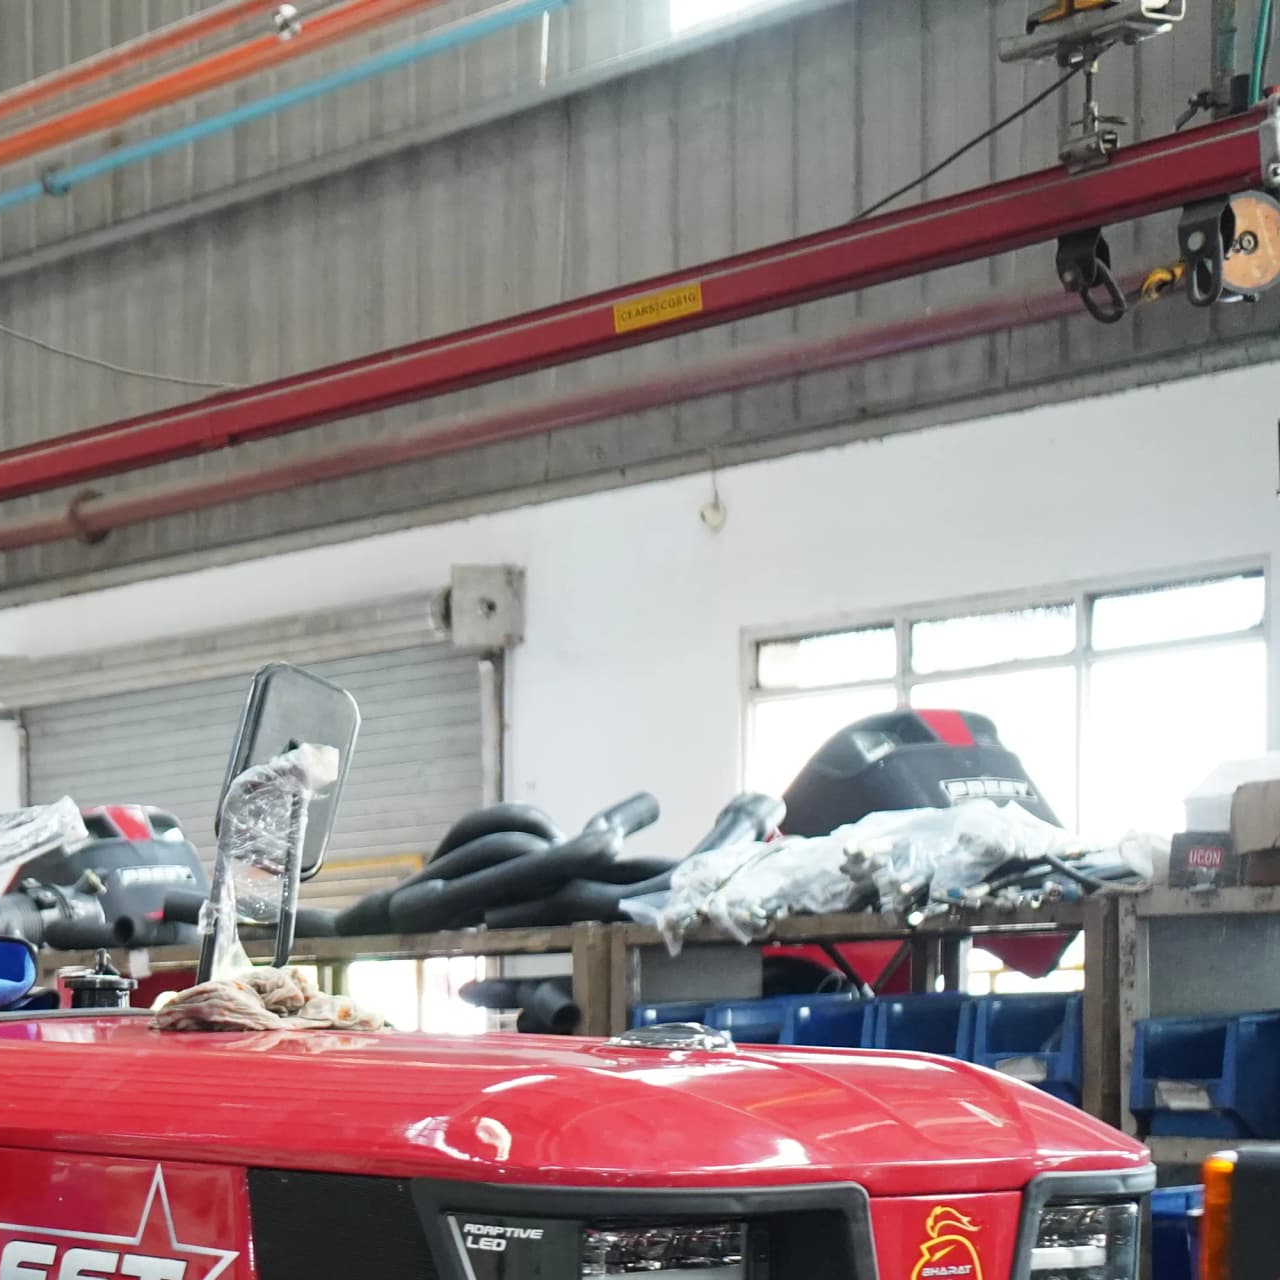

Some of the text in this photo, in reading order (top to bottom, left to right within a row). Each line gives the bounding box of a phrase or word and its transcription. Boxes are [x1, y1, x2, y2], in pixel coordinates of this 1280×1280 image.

[463, 1223, 544, 1239] ADAPTIVE
[466, 1235, 507, 1252] LED
[922, 1266, 972, 1276] BHARAT
